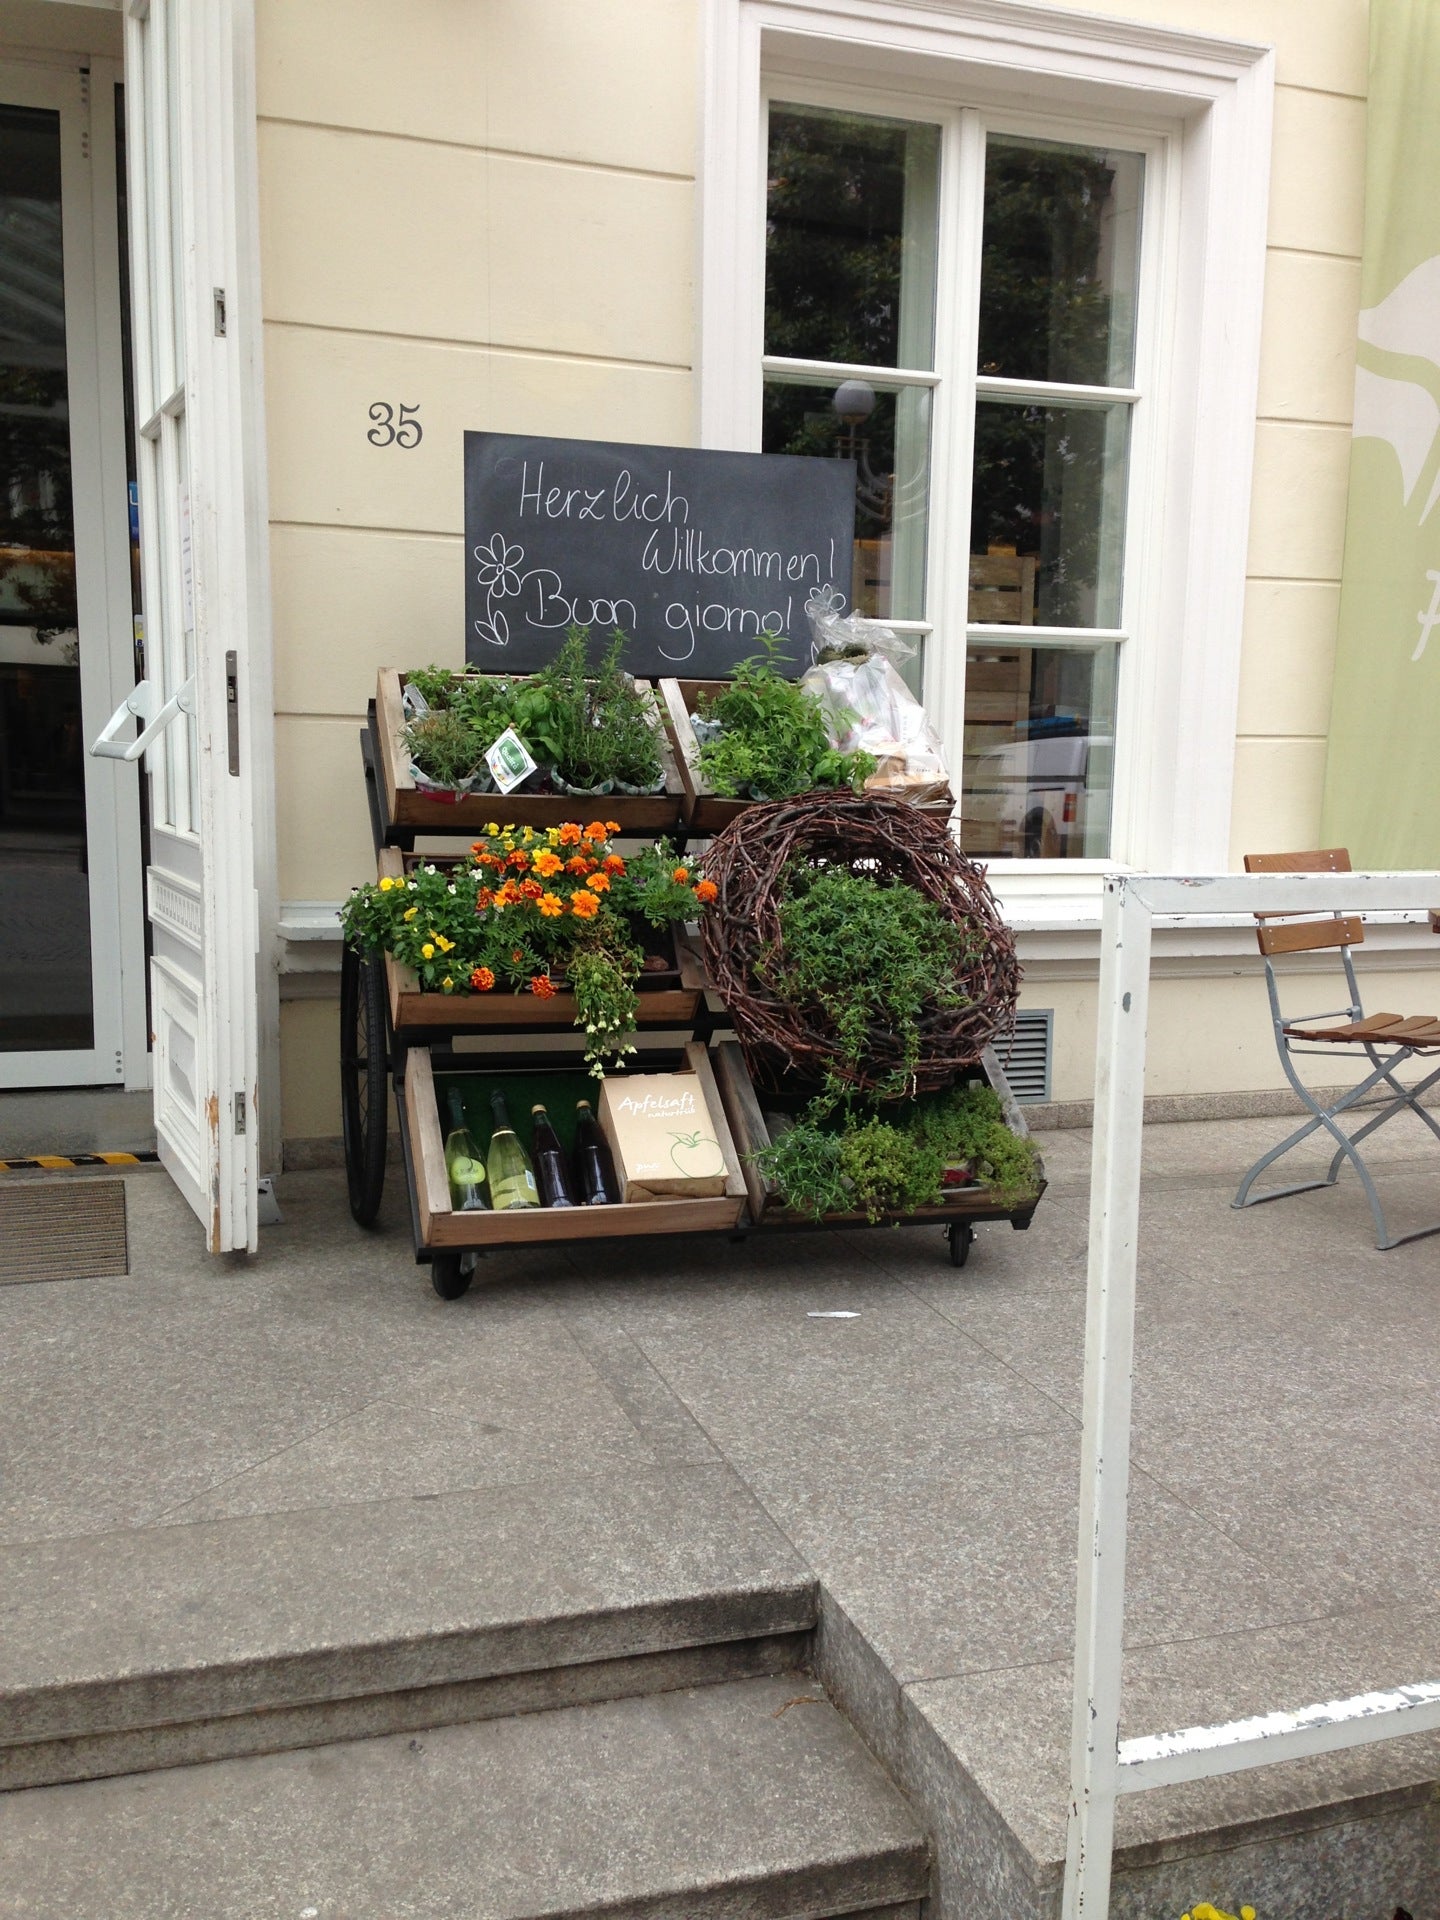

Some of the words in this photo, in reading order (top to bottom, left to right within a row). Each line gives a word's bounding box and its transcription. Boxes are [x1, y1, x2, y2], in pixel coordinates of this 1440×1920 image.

[367, 401, 423, 449] 35
[519, 460, 689, 524] Herzlich
[642, 526, 835, 584] Willkommen!
[520, 568, 636, 629] Buon
[657, 591, 792, 661] giorno!
[617, 1091, 697, 1117] Apfelsaft
